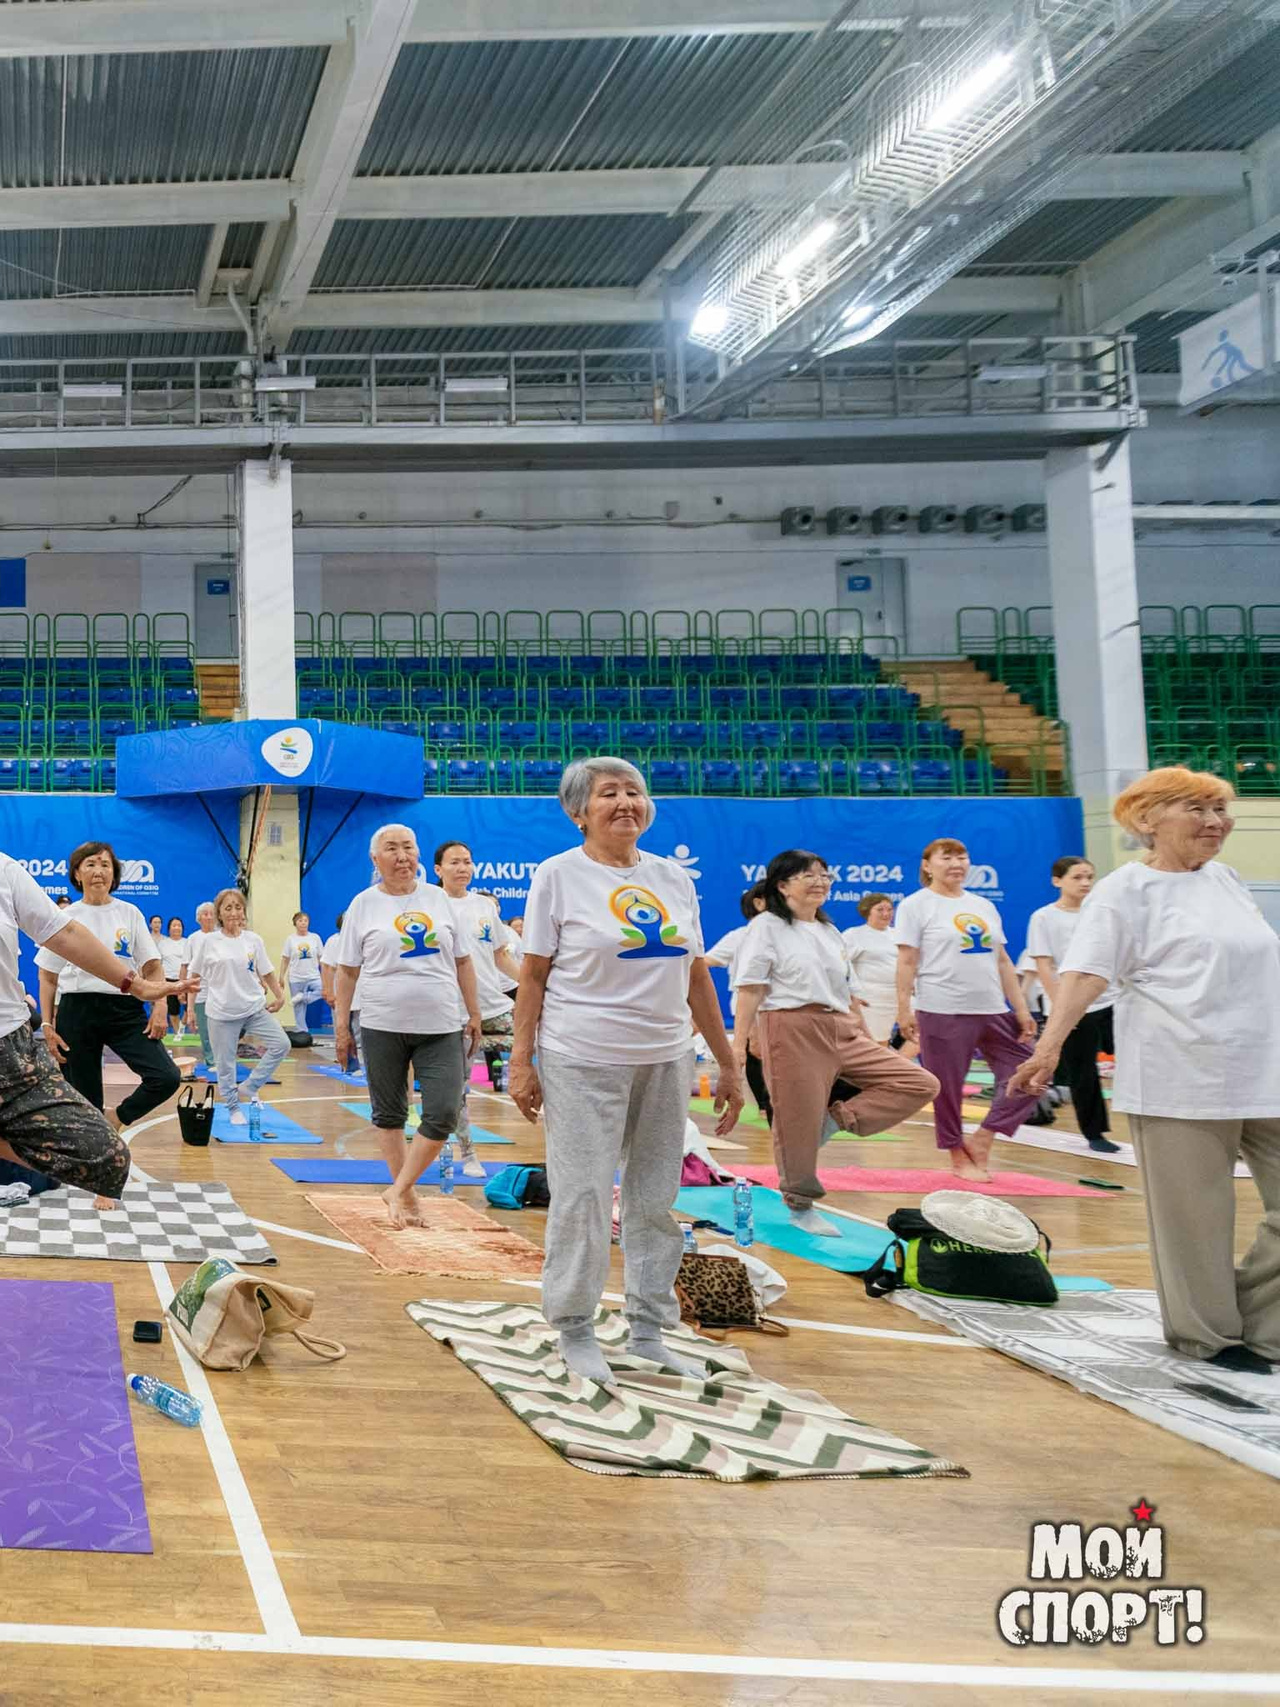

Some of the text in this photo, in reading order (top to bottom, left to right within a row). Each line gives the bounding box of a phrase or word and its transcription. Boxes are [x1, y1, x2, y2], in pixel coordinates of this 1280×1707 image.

[473, 862, 539, 880] YAKUT
[847, 865, 904, 882] 2024
[40, 886, 68, 895] mes
[493, 887, 529, 898] Childr
[834, 890, 861, 901] Asia
